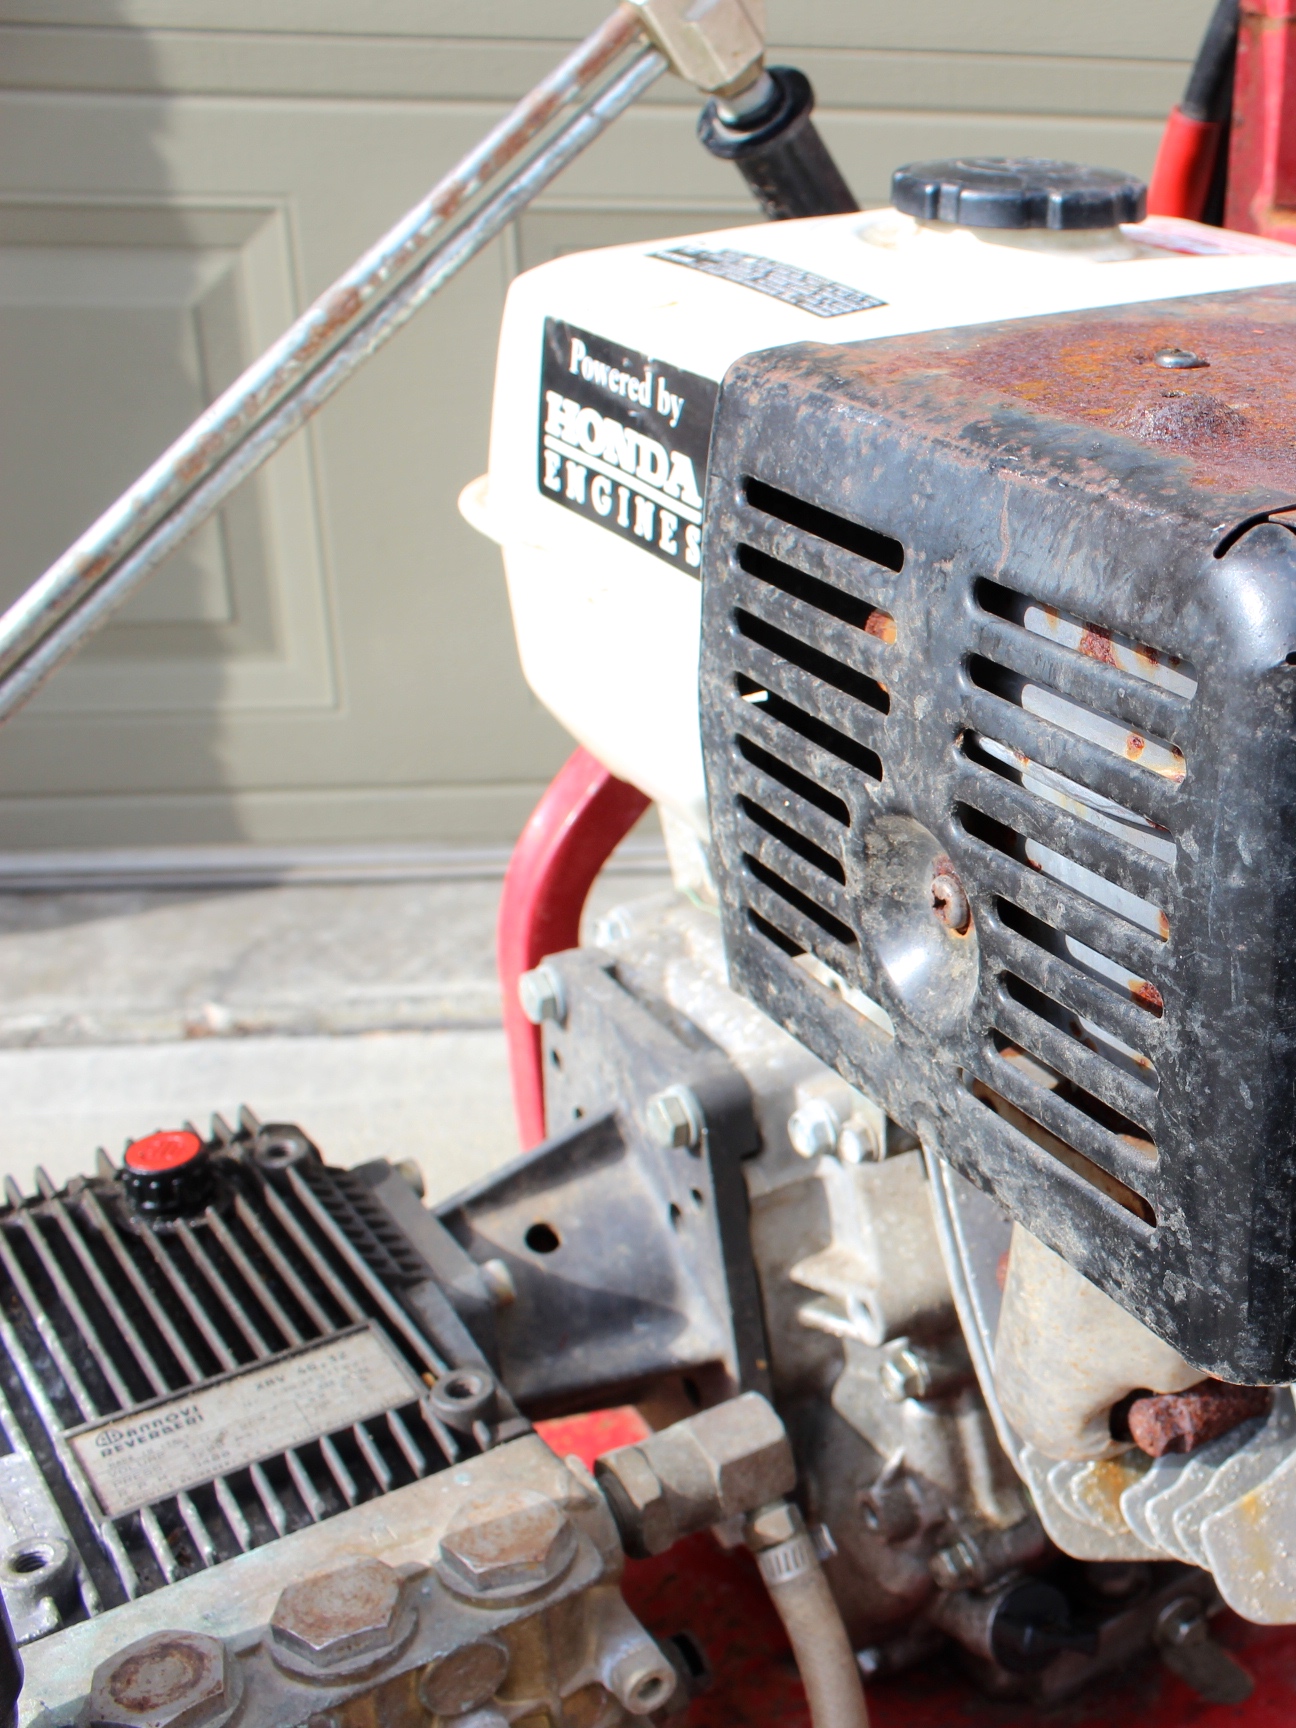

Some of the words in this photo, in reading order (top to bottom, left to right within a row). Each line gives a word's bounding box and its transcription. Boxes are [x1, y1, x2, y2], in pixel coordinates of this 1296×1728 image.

[569, 337, 652, 408] Powered
[658, 377, 685, 427] by
[545, 391, 703, 509] HONDA
[544, 449, 702, 568] ENGINES
[98, 1412, 205, 1458] REVERBERI
